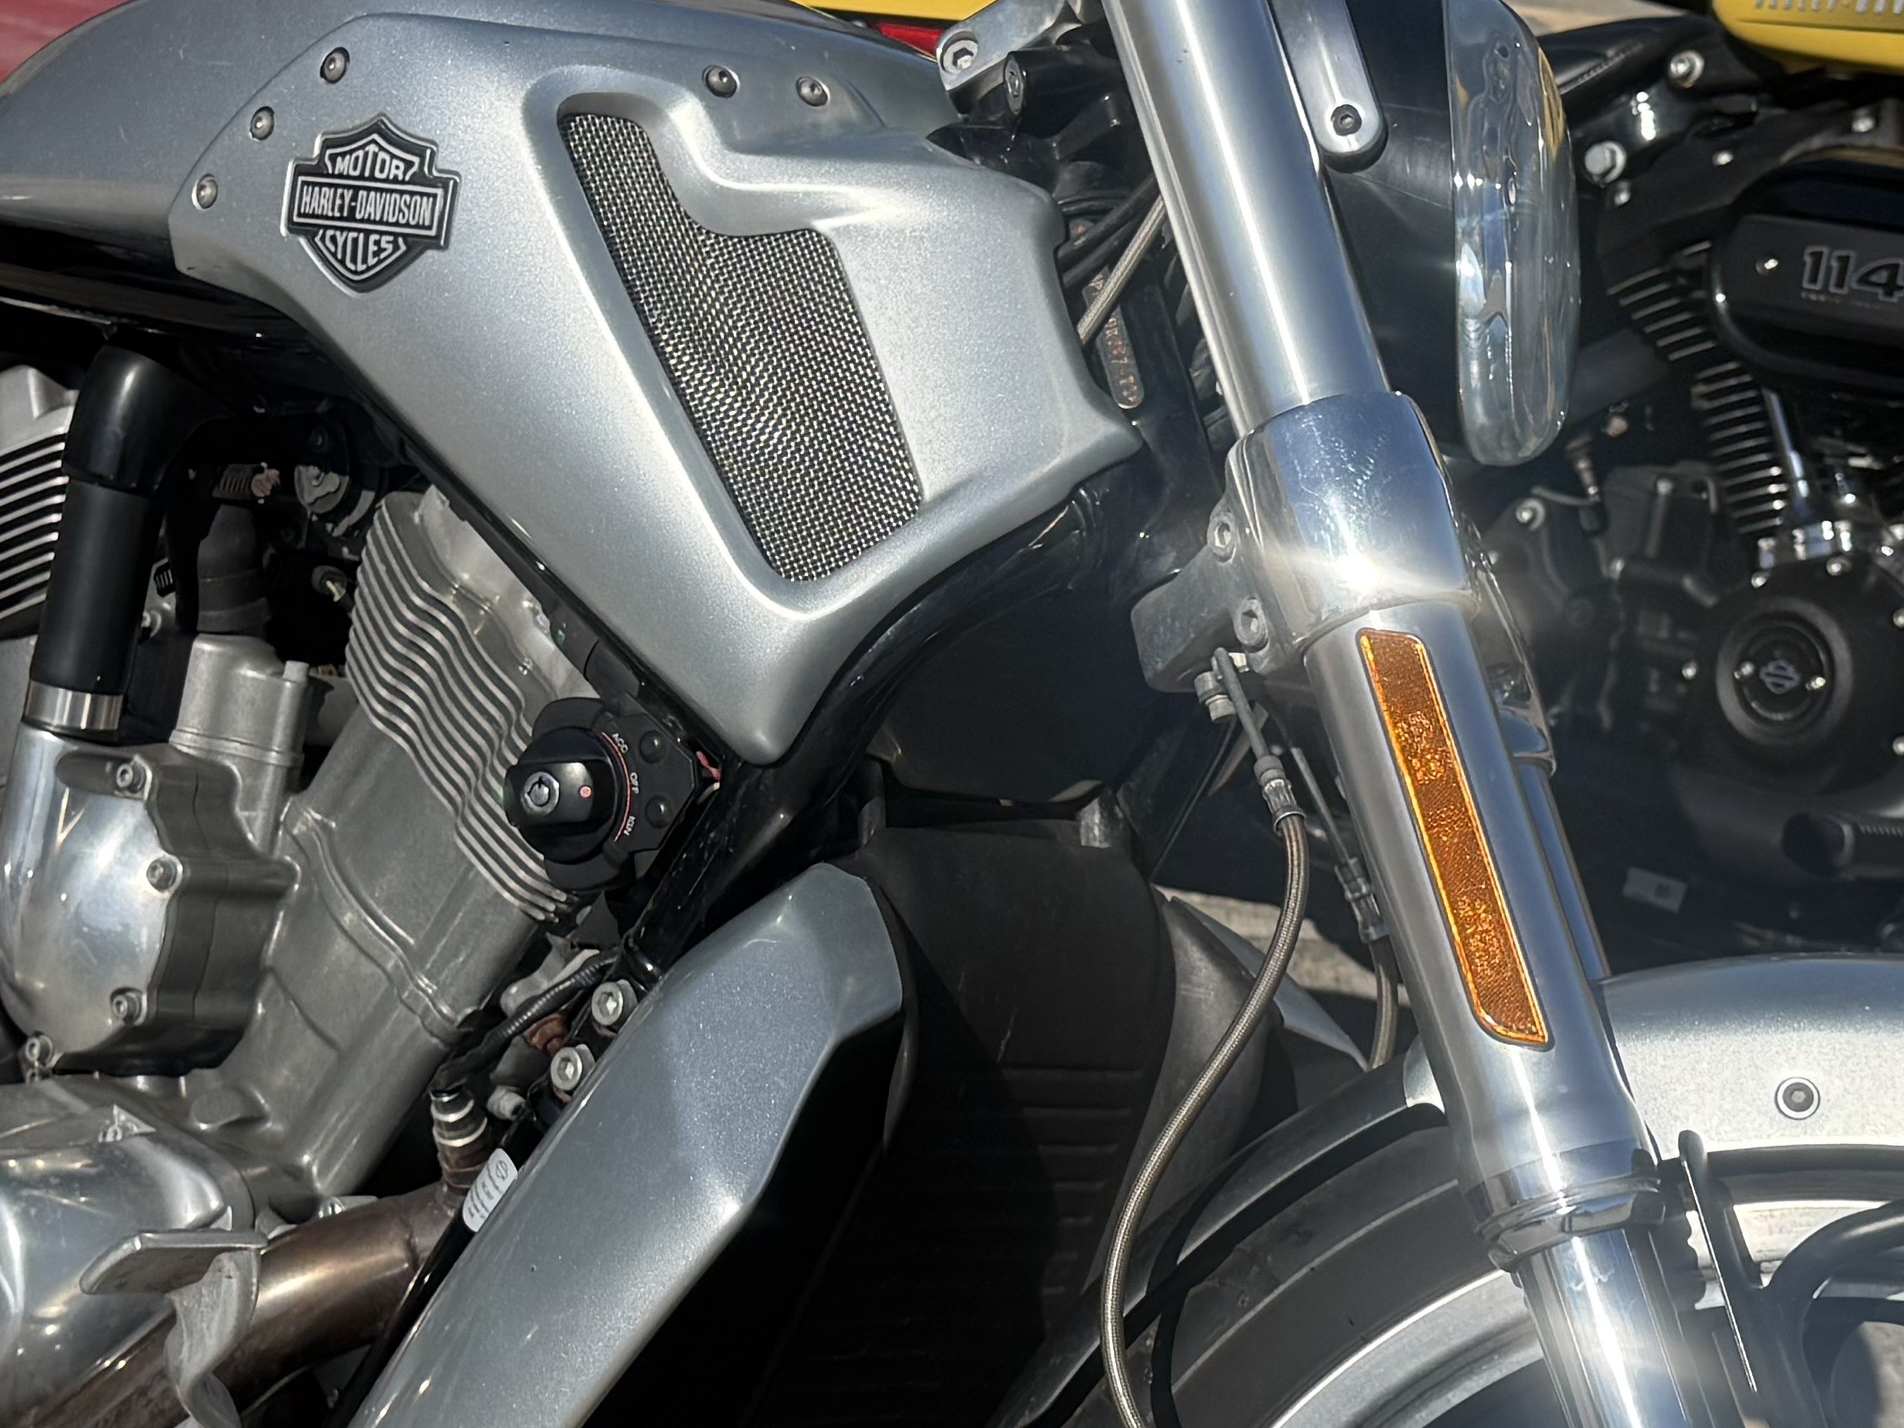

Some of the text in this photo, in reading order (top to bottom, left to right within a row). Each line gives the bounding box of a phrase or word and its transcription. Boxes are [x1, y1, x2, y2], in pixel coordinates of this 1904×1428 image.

[334, 142, 405, 182] MOTOR
[300, 184, 434, 227] HARLEY-DAVIDSON
[325, 228, 395, 273] CYCLES
[611, 732, 629, 754] ACC
[629, 772, 640, 795] OFF
[623, 815, 636, 837] IGN
